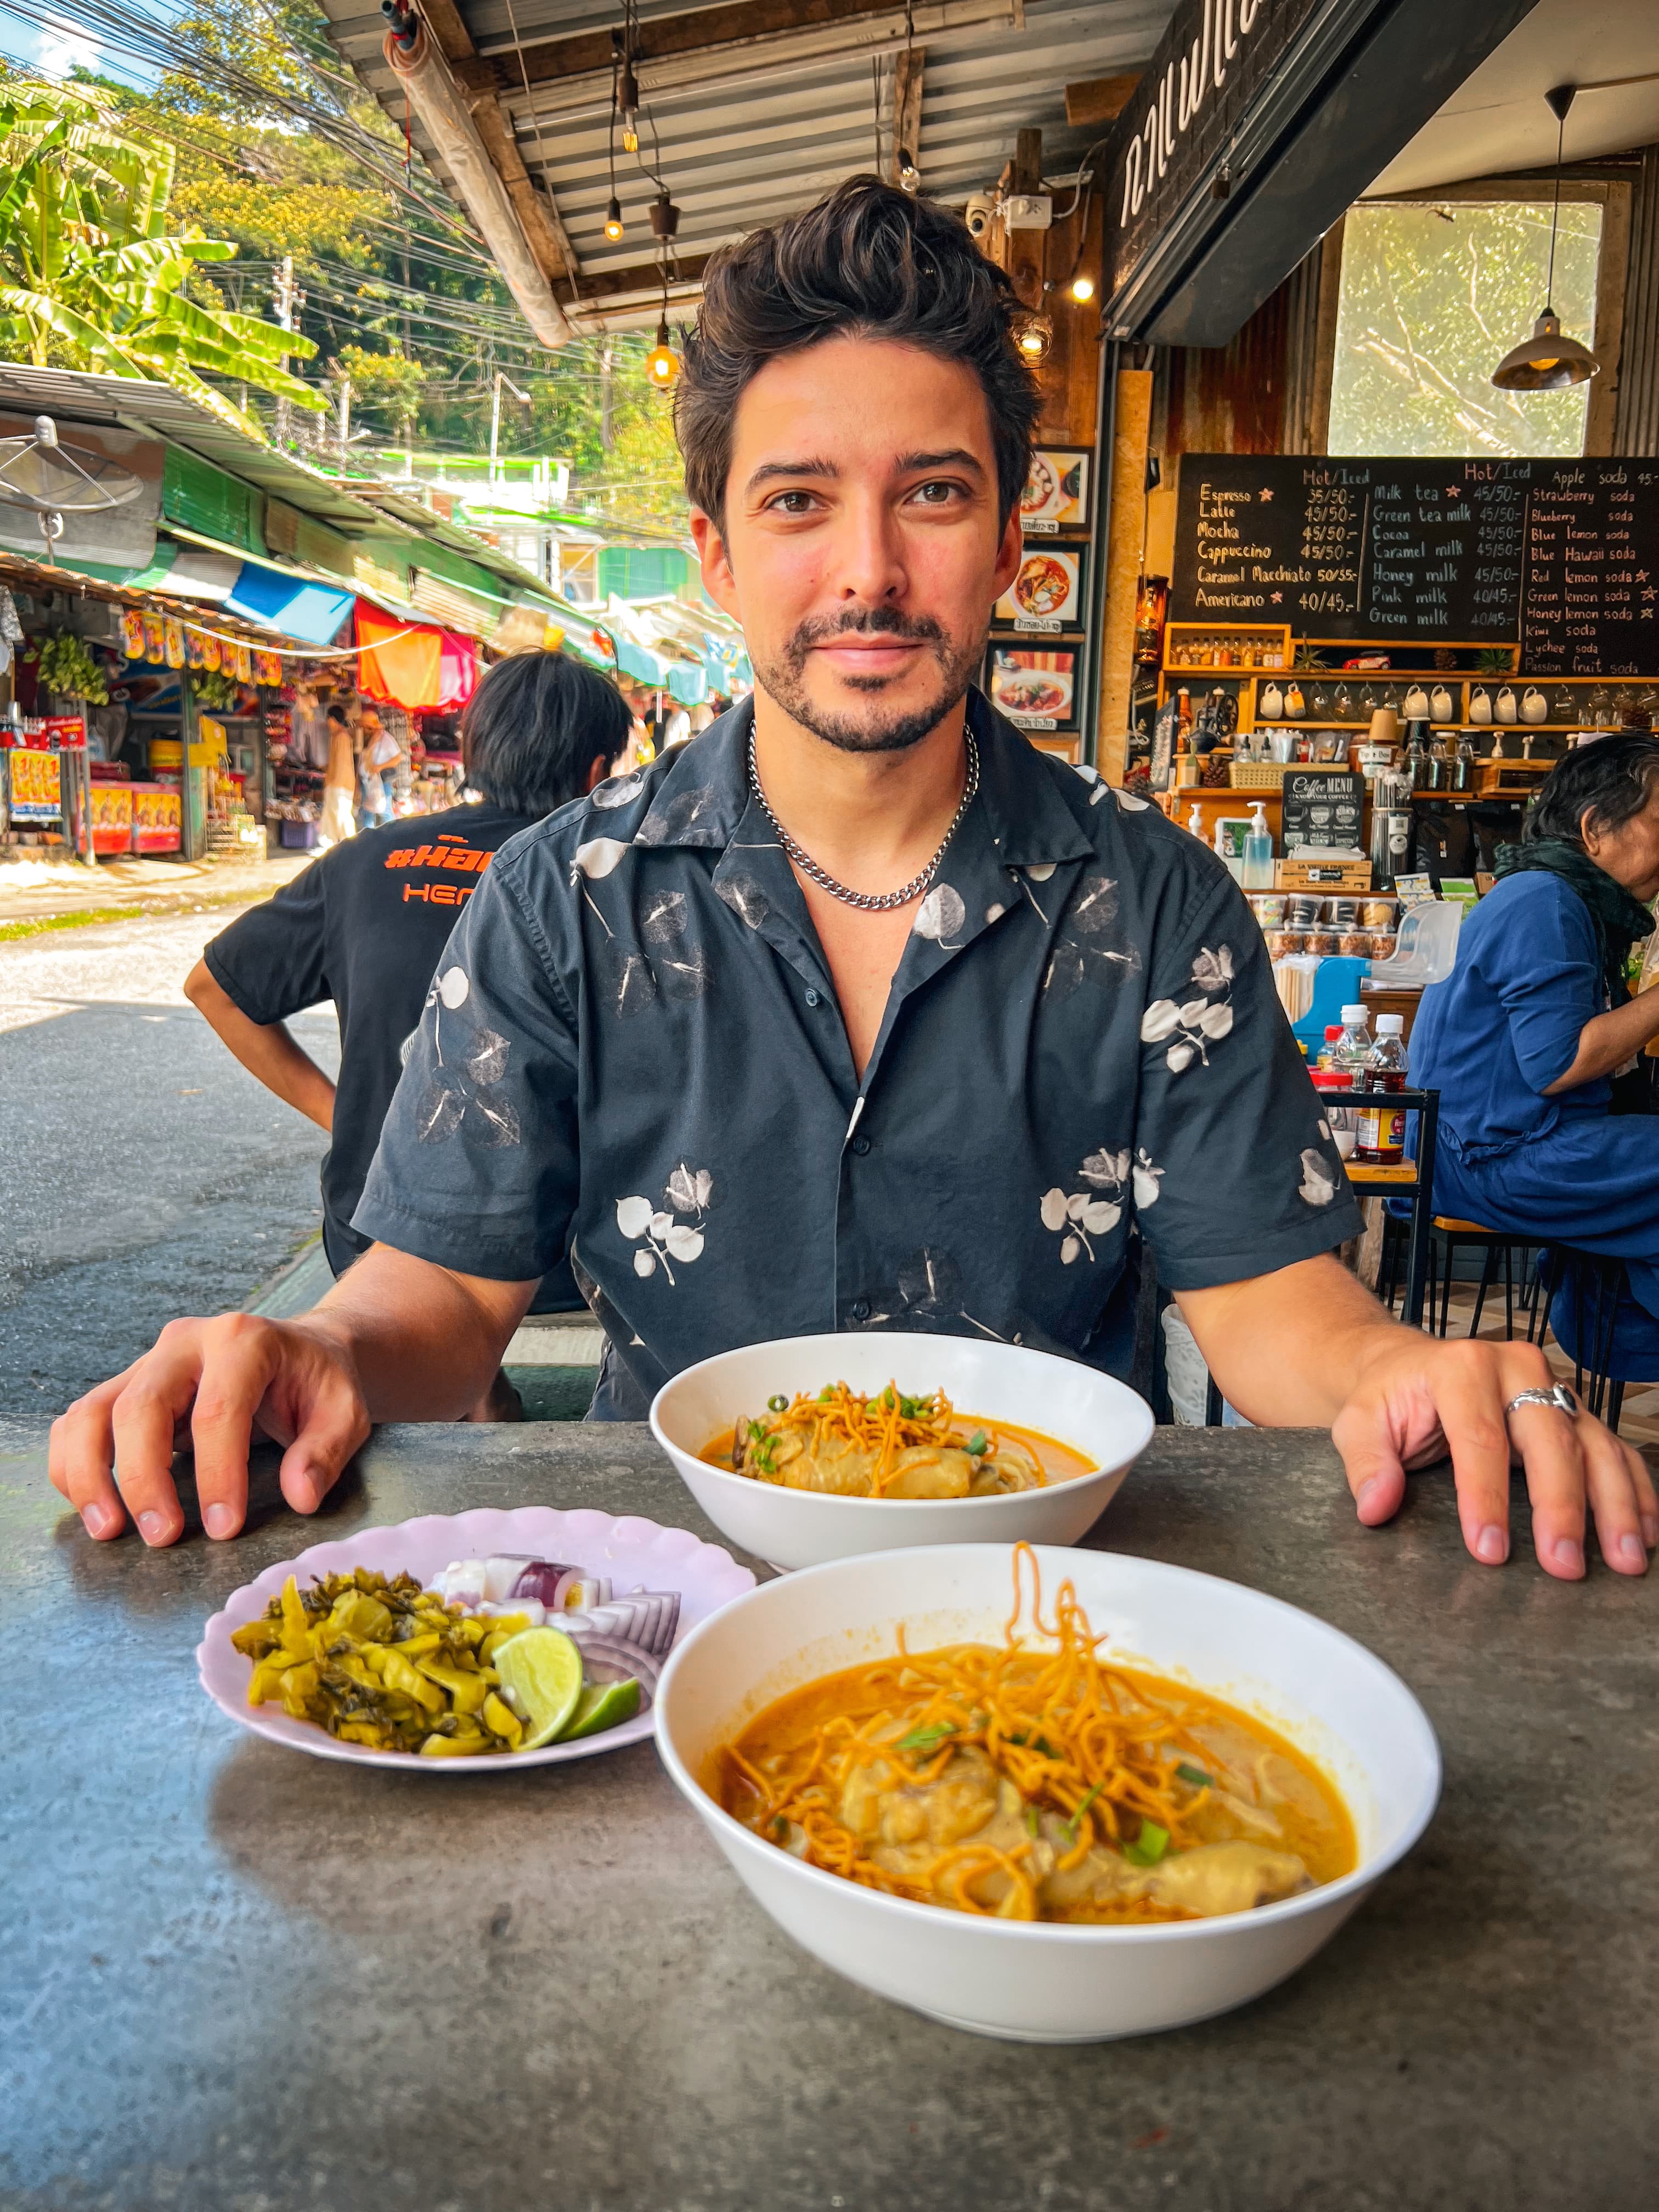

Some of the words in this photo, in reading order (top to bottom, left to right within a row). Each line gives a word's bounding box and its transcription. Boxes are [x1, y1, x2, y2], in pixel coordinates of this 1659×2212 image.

[1464, 461, 1531, 481] Hot/Iced
[1552, 467, 1585, 490] Apple
[1599, 466, 1627, 485] soda
[1200, 483, 1251, 504] Espresso
[1374, 483, 1402, 500] Milk
[1415, 483, 1439, 501] tea
[1533, 488, 1594, 504] Strawberry
[1610, 489, 1635, 503] soda
[1373, 504, 1411, 522] Green
[1419, 506, 1442, 522] tea
[1447, 503, 1471, 521] milk
[1532, 509, 1576, 524] Blueberry
[1607, 509, 1633, 522] soda
[1197, 521, 1240, 539] Mocha
[1372, 524, 1409, 540] Cocoa
[1531, 527, 1556, 541] Blue
[1567, 525, 1598, 540] lemon
[1606, 528, 1630, 540] soda
[1197, 540, 1272, 566] Cappuccino
[1373, 541, 1425, 558] Caramel
[1435, 539, 1463, 556] milk
[1531, 546, 1555, 561] Blue
[1565, 546, 1605, 561] Hawaii
[1609, 545, 1636, 560] soda
[1197, 566, 1245, 583] Caramel
[1252, 565, 1312, 583] Macchiato
[1373, 562, 1414, 586] Honey
[1426, 562, 1458, 582] milk
[1531, 569, 1549, 583] Red
[1565, 567, 1598, 584] lemon
[1605, 570, 1632, 583] soda
[1195, 588, 1265, 607] Americano
[1372, 585, 1402, 603] Pink
[1415, 586, 1448, 603] milk
[1527, 588, 1559, 602] Green
[1565, 586, 1598, 602] lemon
[1604, 588, 1630, 602] soda
[1369, 606, 1408, 624] Green
[1417, 608, 1448, 625] milk
[1527, 606, 1562, 623] Honey
[1565, 606, 1599, 620] lemon
[1604, 607, 1633, 621] soda
[1526, 624, 1549, 637] Kiwi
[1566, 624, 1596, 637] soda
[1525, 639, 1565, 658] Lychee
[1575, 642, 1598, 654] soda
[1525, 657, 1562, 673] Passion
[1572, 656, 1602, 673] fruit
[1610, 662, 1639, 675] soda
[1293, 776, 1326, 798] Coffee
[1327, 777, 1353, 793] MENU
